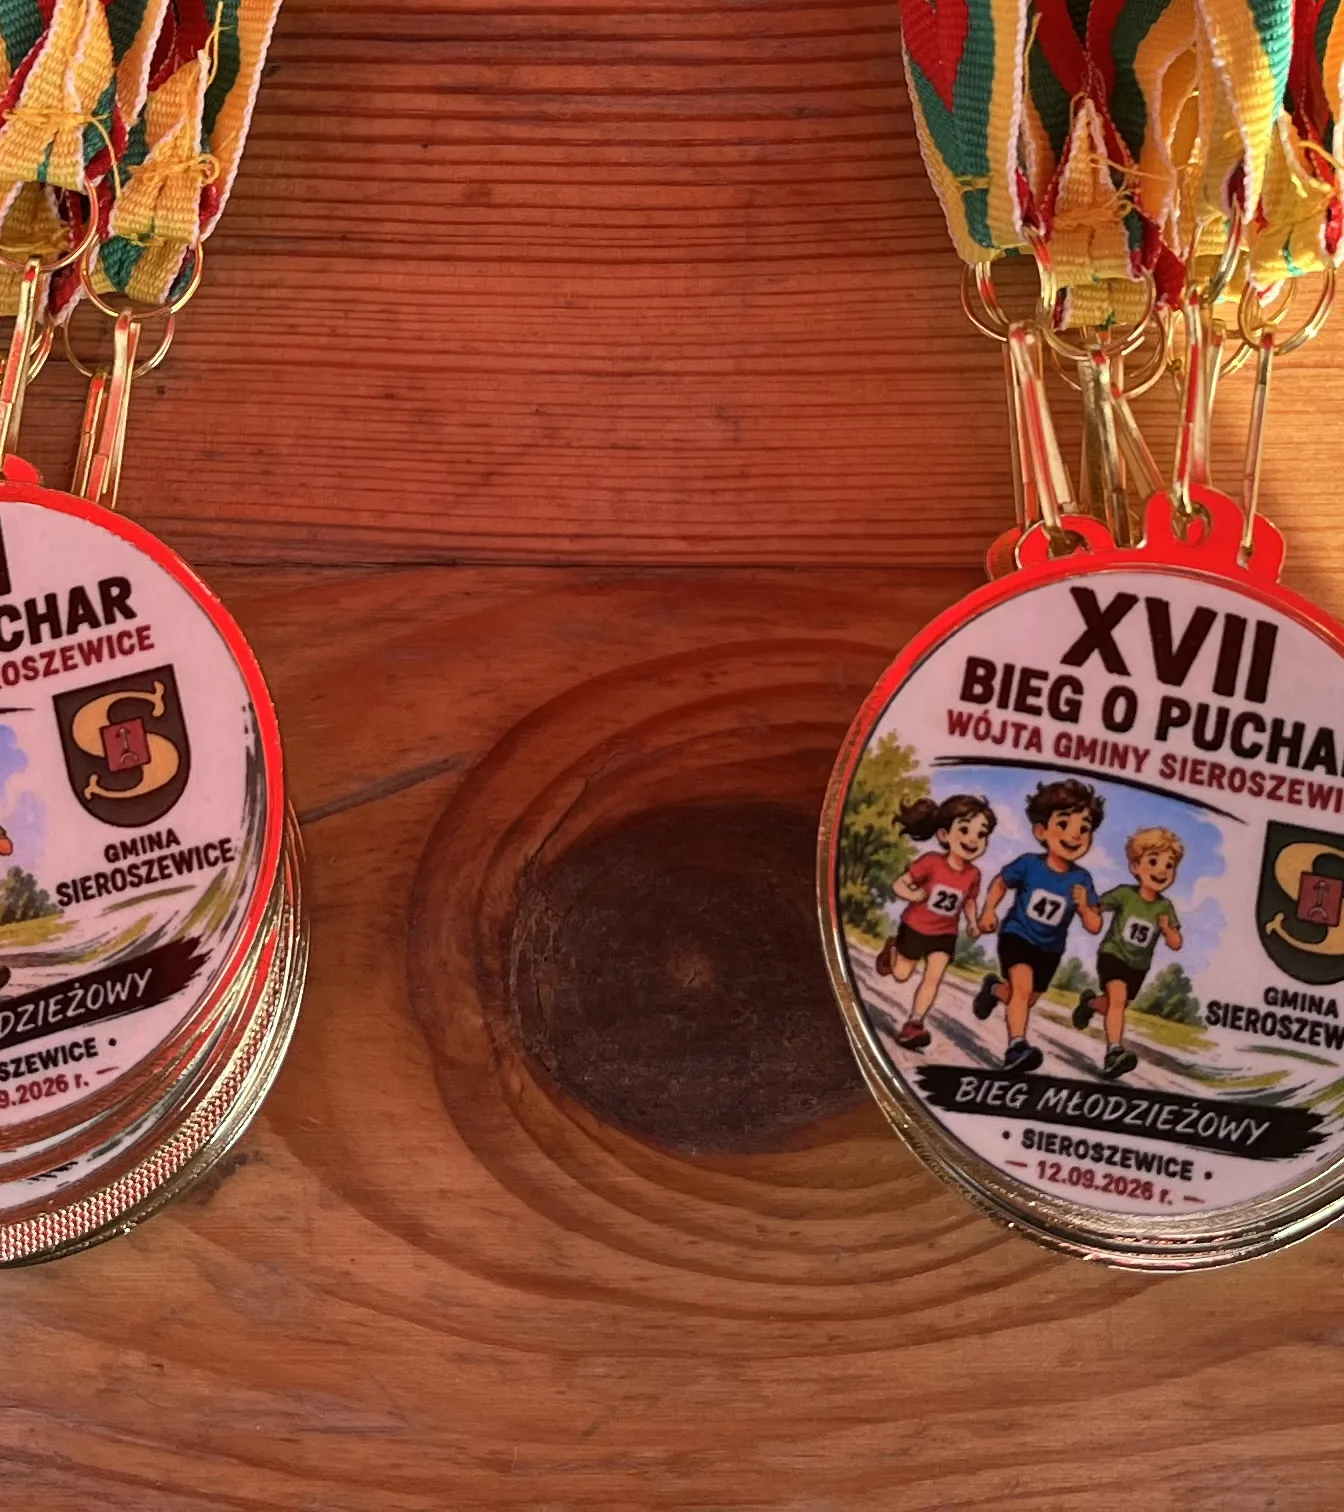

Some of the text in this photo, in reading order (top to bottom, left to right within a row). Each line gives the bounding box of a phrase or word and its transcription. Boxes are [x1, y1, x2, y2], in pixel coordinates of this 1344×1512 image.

[1060, 587, 1278, 703] XVII
[960, 657, 1083, 723] BIEG
[1102, 685, 1139, 732] O
[946, 709, 1045, 755] WÓJTA
[1054, 732, 1150, 774] GMINY
[104, 827, 181, 863] GMINA
[56, 839, 235, 908] SIEROSZEWICE
[932, 890, 958, 913] 23
[1032, 897, 1060, 922] 47
[1128, 922, 1149, 943] 15
[1263, 986, 1339, 1018] GMINA
[955, 1074, 1271, 1146] BIEG MŁODZIEŻOWY
[1021, 1128, 1193, 1181] SIEROSZEWICE
[1036, 1159, 1155, 1202] 12.09.2026
